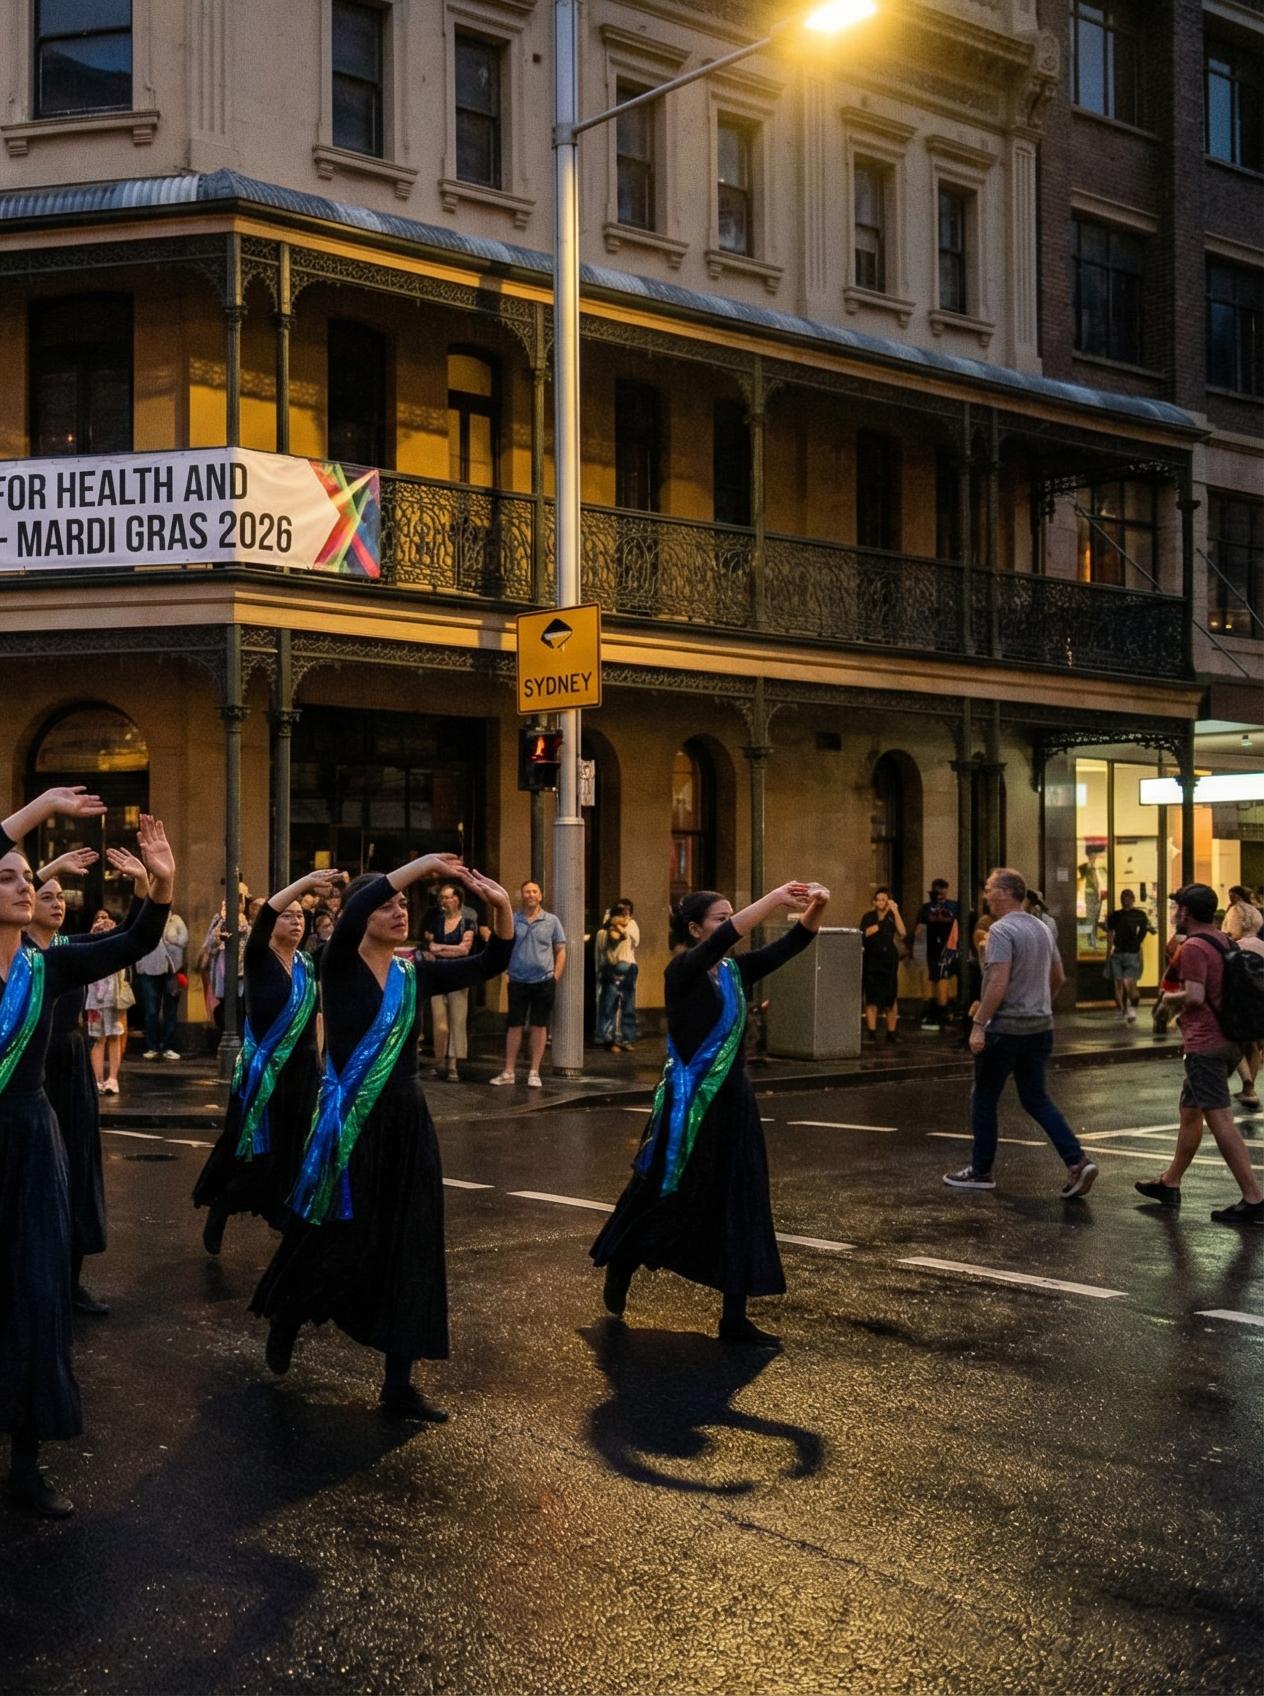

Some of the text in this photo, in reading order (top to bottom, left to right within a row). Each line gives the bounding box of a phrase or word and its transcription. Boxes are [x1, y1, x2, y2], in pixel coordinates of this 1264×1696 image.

[56, 465, 173, 509] HEALTH
[183, 462, 248, 502] AND
[17, 516, 115, 558] MARDI
[125, 511, 208, 553] GRAS
[218, 510, 293, 553] 2026
[523, 671, 593, 698] SYDNEY
